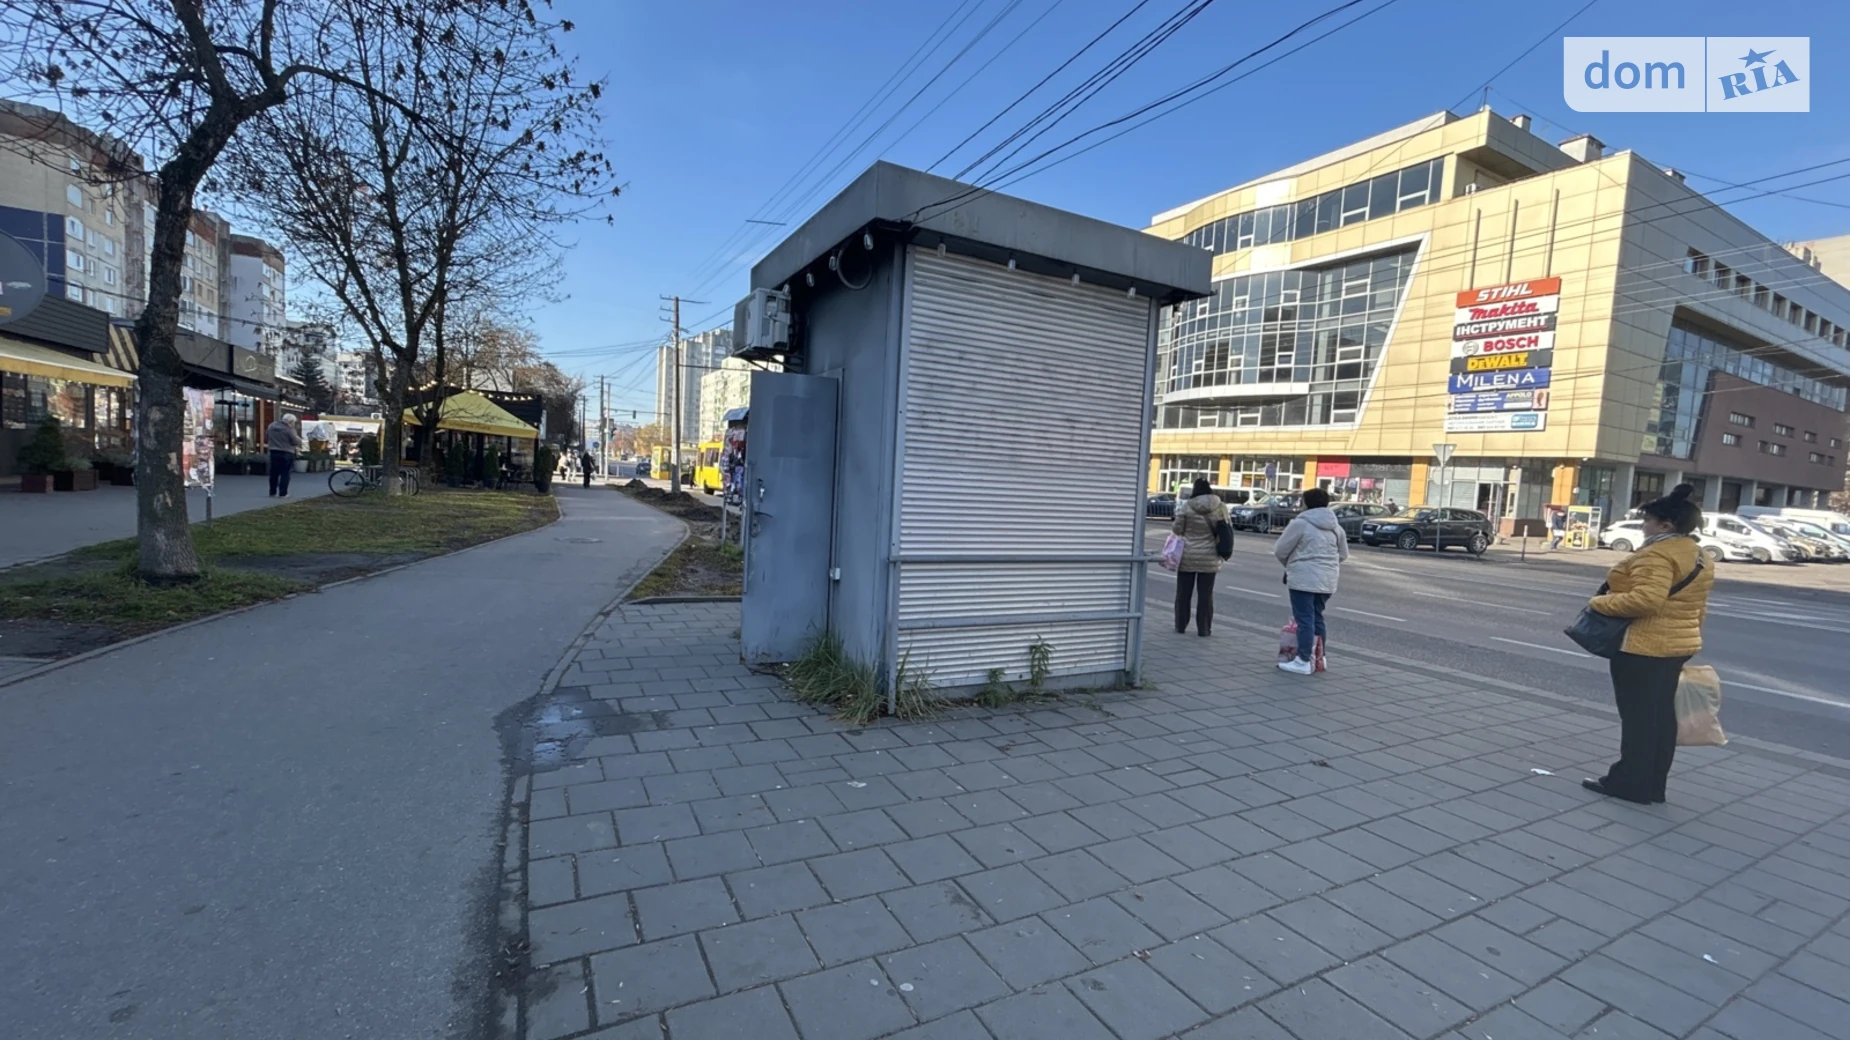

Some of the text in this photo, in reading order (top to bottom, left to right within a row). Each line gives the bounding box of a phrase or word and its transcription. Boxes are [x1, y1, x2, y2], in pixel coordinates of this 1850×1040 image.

[1477, 284, 1532, 302] STIHL
[1457, 316, 1548, 336] ІНСТРУМЕНТ
[1483, 336, 1539, 351] BOSCH
